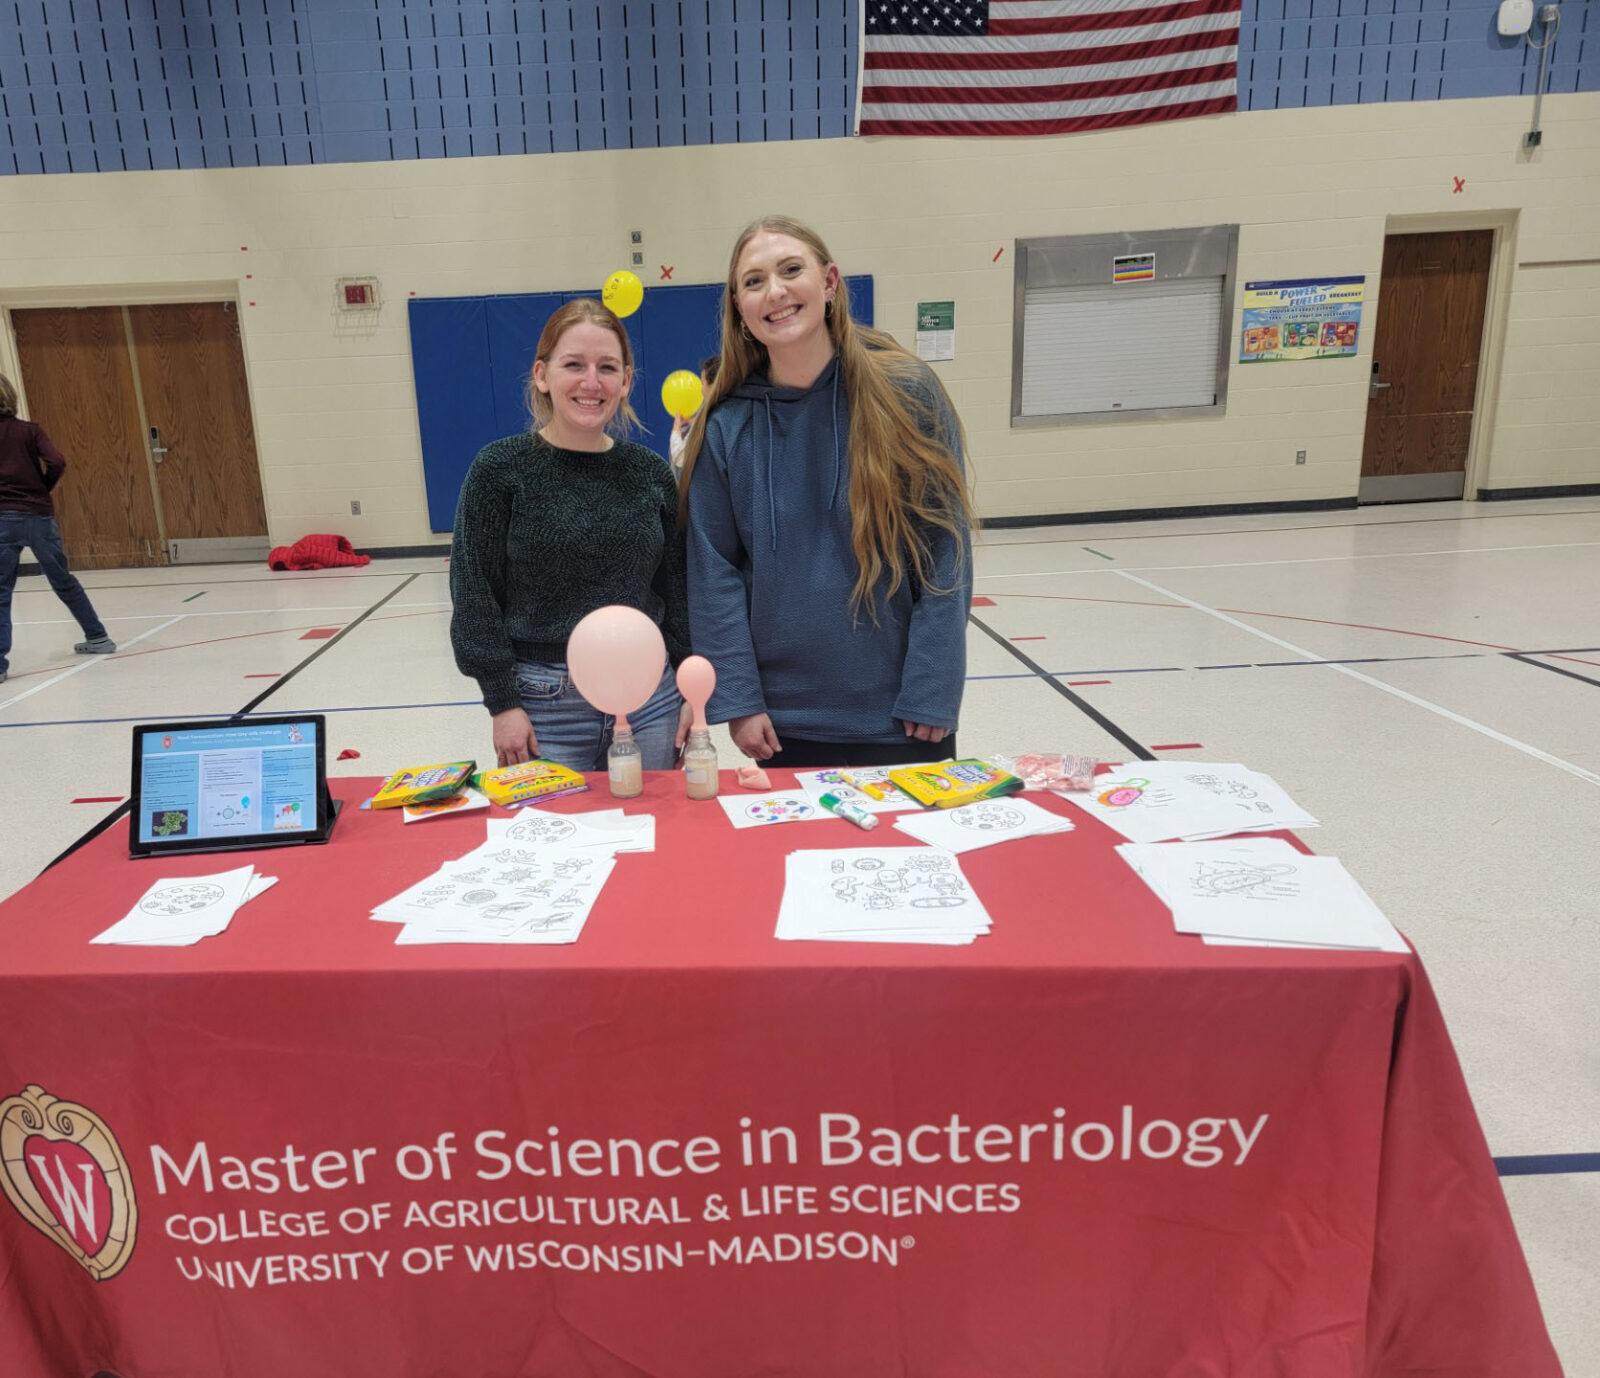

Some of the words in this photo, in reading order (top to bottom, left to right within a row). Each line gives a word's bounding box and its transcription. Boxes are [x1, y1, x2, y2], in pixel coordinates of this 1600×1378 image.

[1280, 285, 1318, 300] POWER
[1289, 294, 1327, 307] FUELED
[150, 1144, 377, 1195] Master
[396, 1131, 457, 1180] of
[475, 1126, 721, 1180] Science
[740, 1117, 797, 1166] in
[820, 1105, 1268, 1168] Bacteriology
[29, 1153, 98, 1244] W
[165, 1210, 330, 1245] COLLEGE
[339, 1202, 391, 1234] OF
[404, 1195, 691, 1229] AGRICULTURAL
[703, 1193, 731, 1222] &
[741, 1186, 818, 1217] LIFE
[830, 1183, 1021, 1217] SCIENCES
[176, 1249, 390, 1289] UNIVERSITY
[402, 1244, 454, 1275] OF
